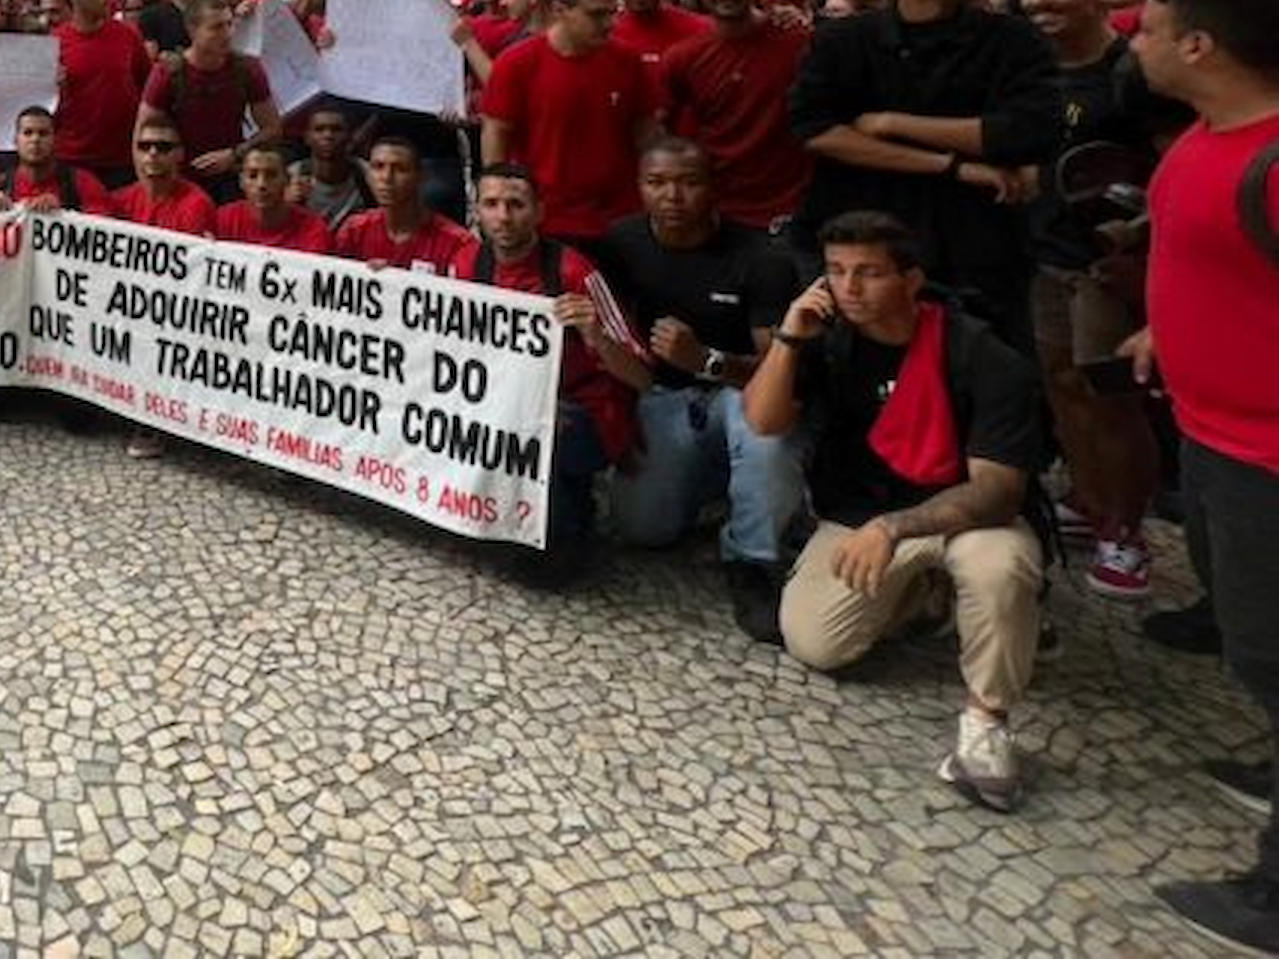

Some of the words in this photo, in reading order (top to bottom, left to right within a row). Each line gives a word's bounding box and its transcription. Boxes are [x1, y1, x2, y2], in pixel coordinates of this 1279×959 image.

[31, 219, 188, 280] BOMBEIROS
[204, 257, 247, 293] TEM
[312, 269, 384, 321] MAIS
[401, 286, 551, 358] CHANCES
[55, 268, 89, 308] DE
[105, 281, 250, 346] ADQUIRIR
[269, 312, 405, 385] CÂNCER
[432, 349, 488, 403] DO
[28, 304, 75, 347] QUE
[90, 322, 132, 367] UM
[154, 337, 381, 435] TRABALHADOR
[145, 391, 188, 424] DELES
[198, 408, 210, 430] E
[216, 414, 260, 445] SUAS
[417, 476, 430, 503] 8
[437, 482, 499, 524] ANOS
[516, 500, 532, 529] ?
